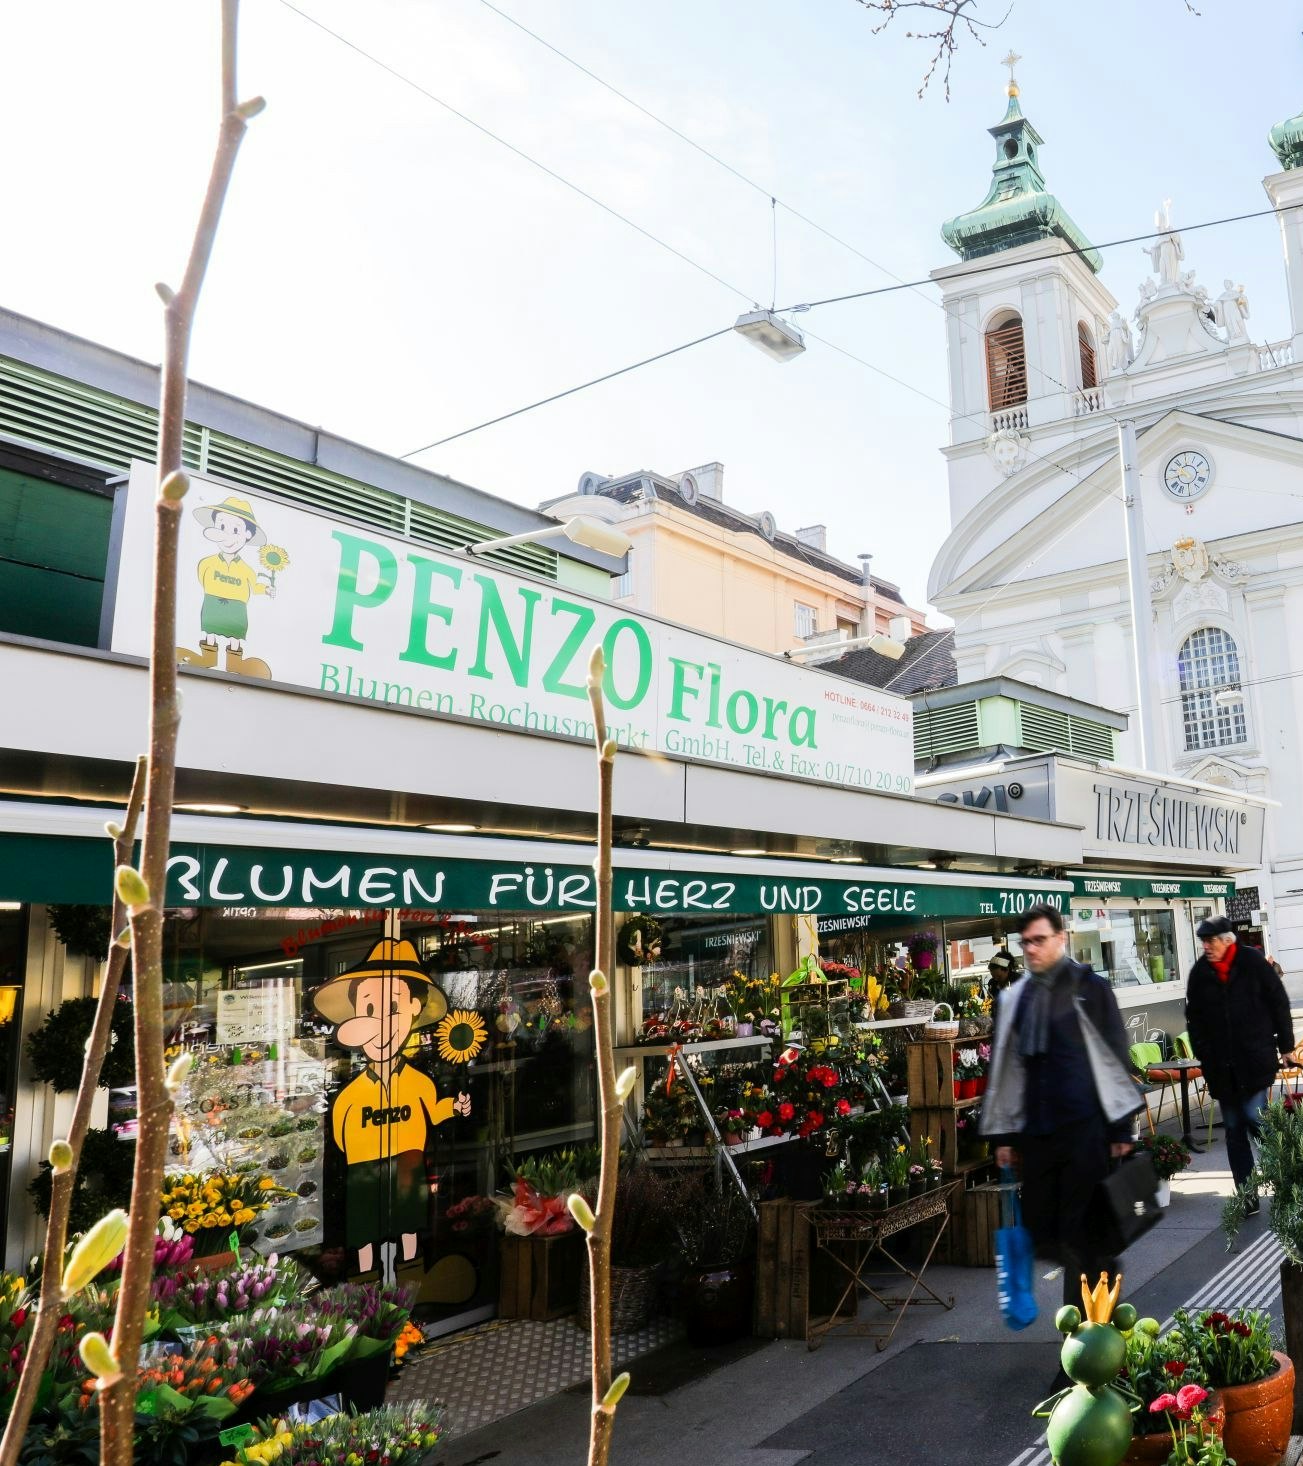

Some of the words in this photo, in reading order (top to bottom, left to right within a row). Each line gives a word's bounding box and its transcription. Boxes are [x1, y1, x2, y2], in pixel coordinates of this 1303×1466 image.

[321, 530, 653, 710] PENZO
[667, 657, 818, 749] Flora
[320, 663, 454, 714] Blumen
[165, 855, 445, 905] BLUMEN
[489, 868, 597, 907] FÜR
[625, 876, 736, 909] HERZ
[760, 886, 822, 912] UND
[843, 886, 916, 912] SEELE
[980, 902, 998, 915] TEL.
[1000, 892, 1025, 914] 710
[362, 1105, 412, 1128] Penzo
